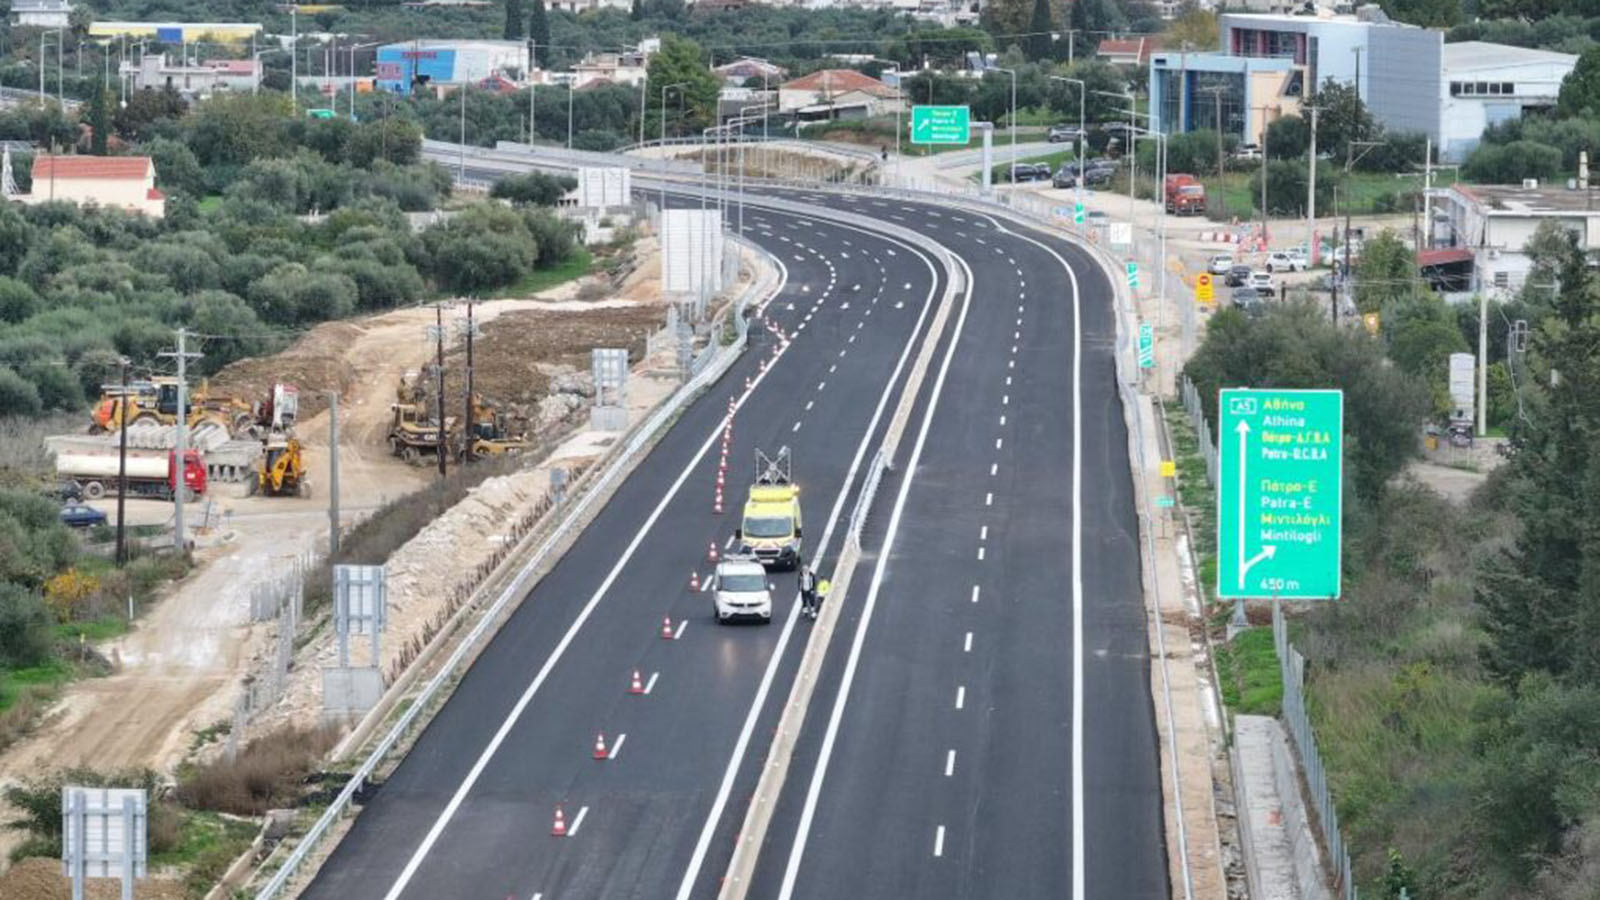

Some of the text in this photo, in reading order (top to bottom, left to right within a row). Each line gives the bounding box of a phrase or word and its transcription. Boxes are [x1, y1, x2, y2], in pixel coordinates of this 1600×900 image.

[1262, 414, 1305, 428] Athina
[1261, 530, 1321, 544] Mintilogli
[1286, 580, 1300, 591] m
